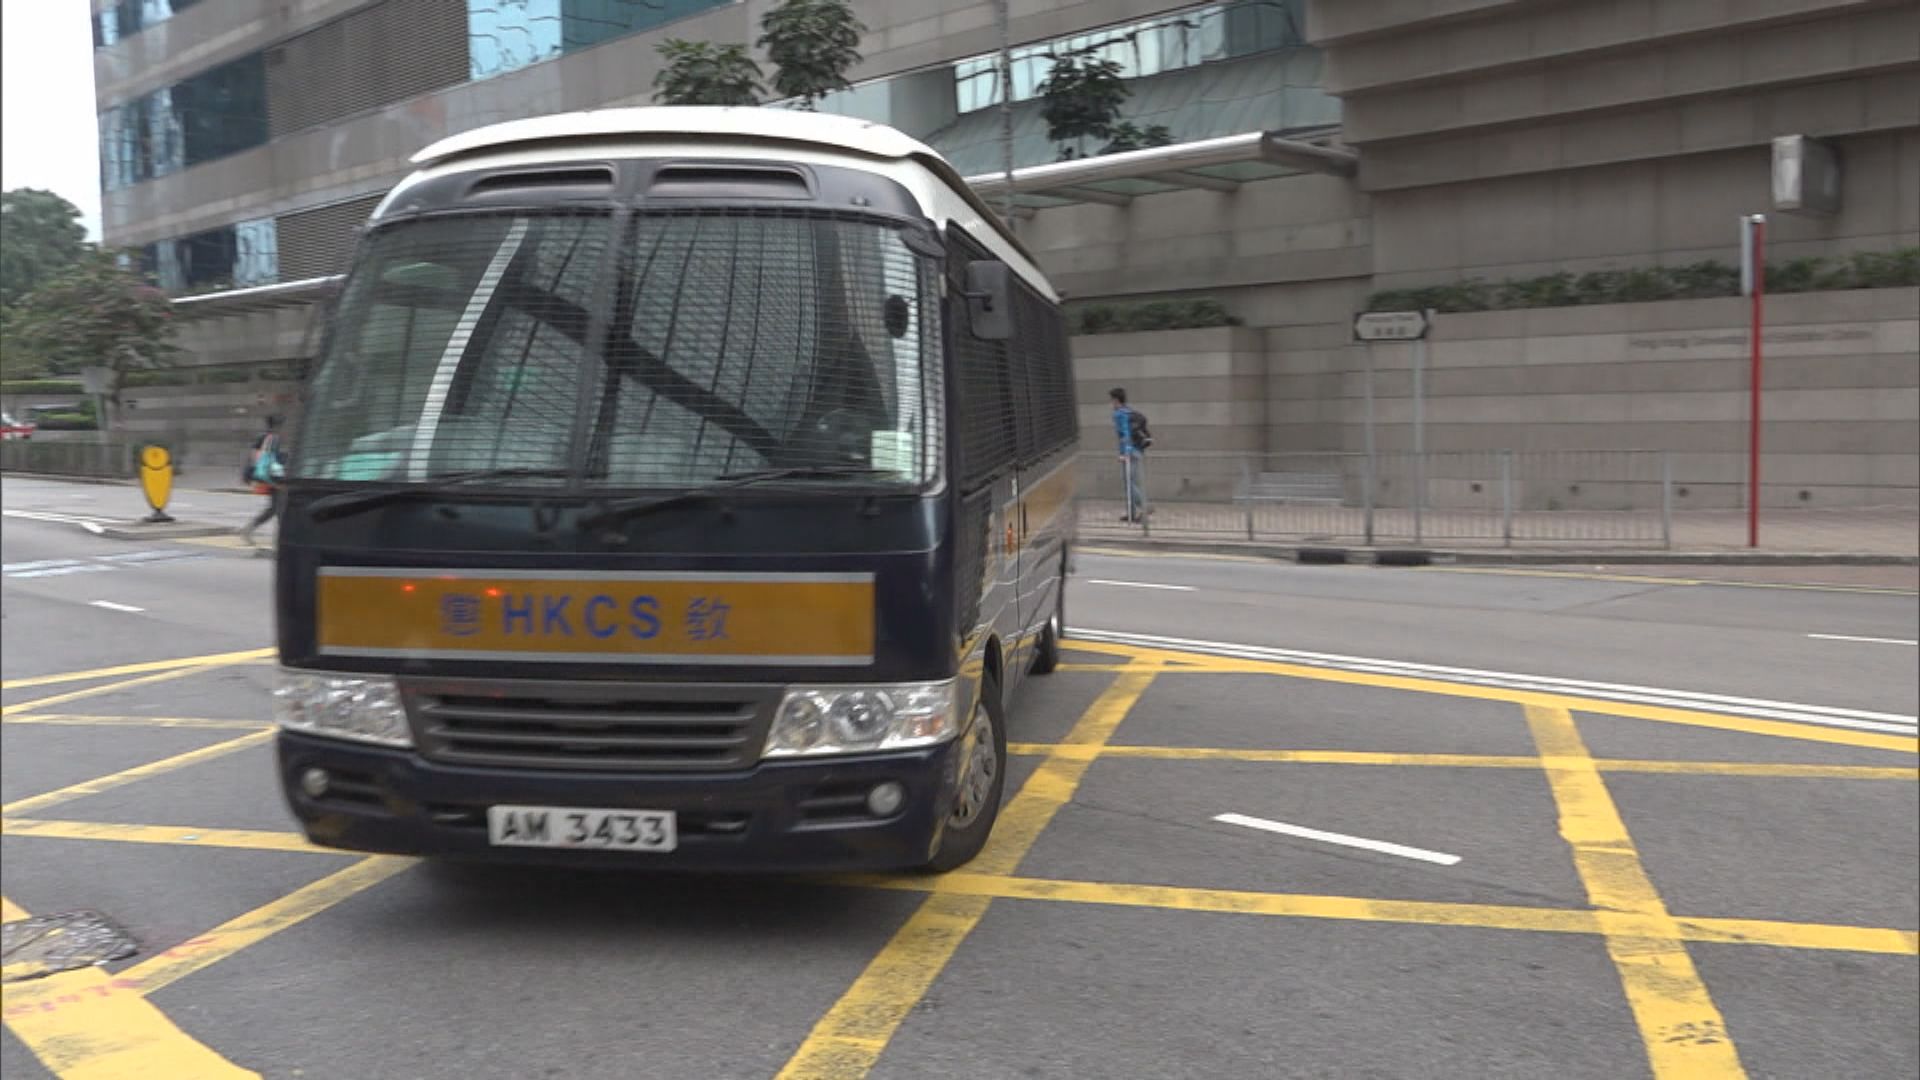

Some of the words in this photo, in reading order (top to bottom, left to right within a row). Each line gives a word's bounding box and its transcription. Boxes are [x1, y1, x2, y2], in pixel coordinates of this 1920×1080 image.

[503, 594, 662, 639] HKCS
[501, 812, 549, 842] AM
[565, 813, 667, 845] 3433
